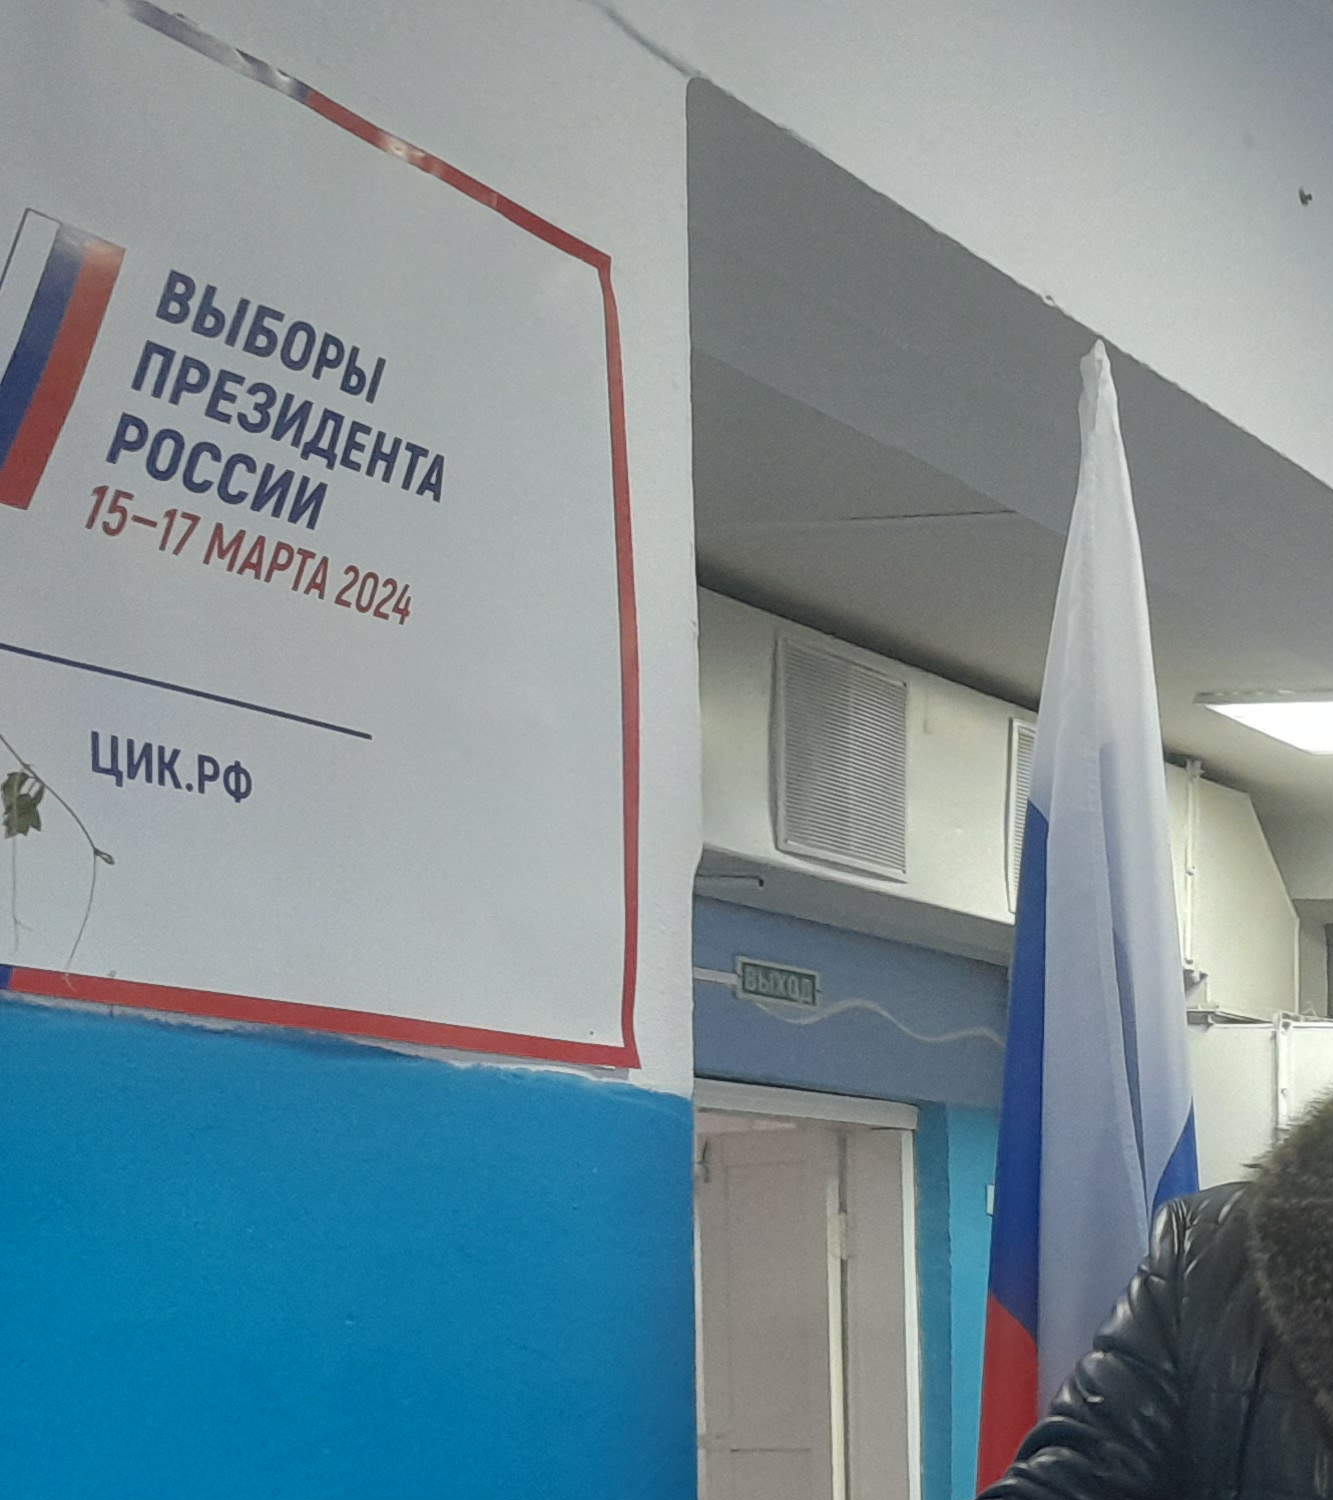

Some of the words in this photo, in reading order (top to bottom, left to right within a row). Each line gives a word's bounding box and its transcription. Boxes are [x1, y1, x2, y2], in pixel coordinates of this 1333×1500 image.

[155, 269, 387, 404] ВЫБОРЫ
[105, 411, 328, 531] РОССИИ
[131, 339, 447, 503] ПРЕЗИДЕНТА
[202, 522, 331, 600] МАРТА
[333, 563, 412, 625] 2024
[89, 729, 253, 803] ЦИК.РФ
[745, 968, 813, 1003] ВЫХОД
